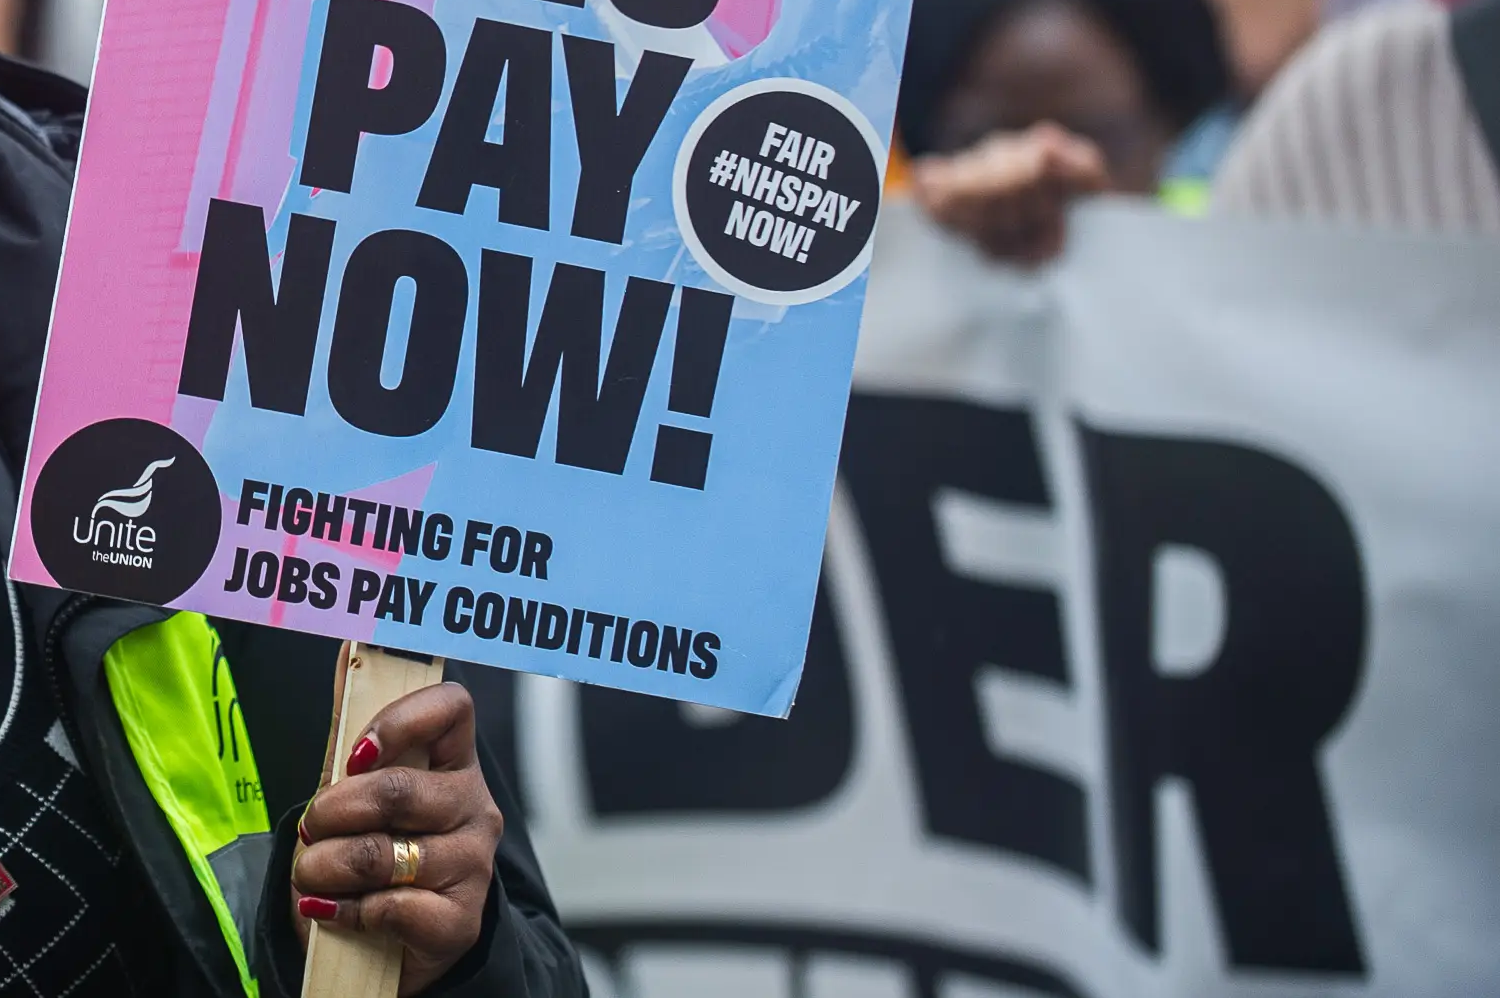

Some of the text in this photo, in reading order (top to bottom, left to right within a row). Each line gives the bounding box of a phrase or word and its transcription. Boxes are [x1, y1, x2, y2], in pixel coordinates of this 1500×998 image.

[708, 149, 861, 233] #NHSPAY
[758, 121, 836, 180] FAIR
[723, 200, 817, 264] NOW!
[177, 197, 735, 491] NOW!
[236, 478, 553, 580] FIGHTING FOR
[224, 548, 722, 680] JOBS PAY CONDITIONS
